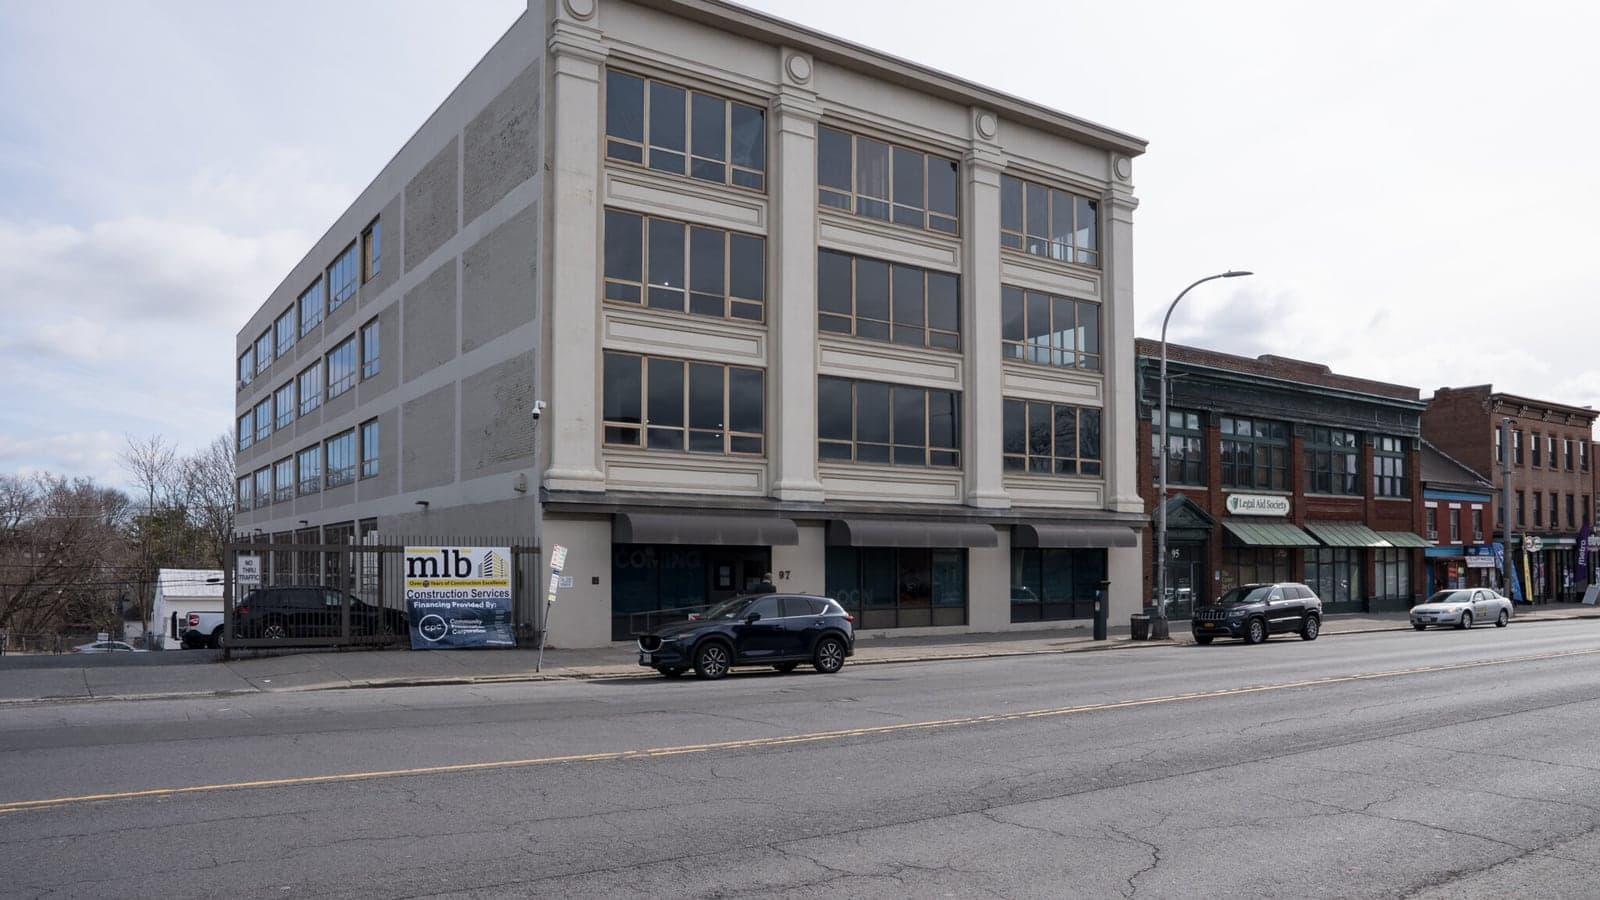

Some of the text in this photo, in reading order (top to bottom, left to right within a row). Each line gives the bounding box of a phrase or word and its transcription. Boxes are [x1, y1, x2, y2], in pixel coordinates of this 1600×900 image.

[1240, 499, 1286, 511] Legal Aid Society
[1171, 549, 1180, 559] 95
[406, 549, 472, 578] mlb
[778, 570, 791, 580] 97
[406, 588, 510, 600] Construction Services
[413, 601, 451, 609] Financing
[452, 601, 484, 609] Provided
[424, 624, 442, 632] cpc
